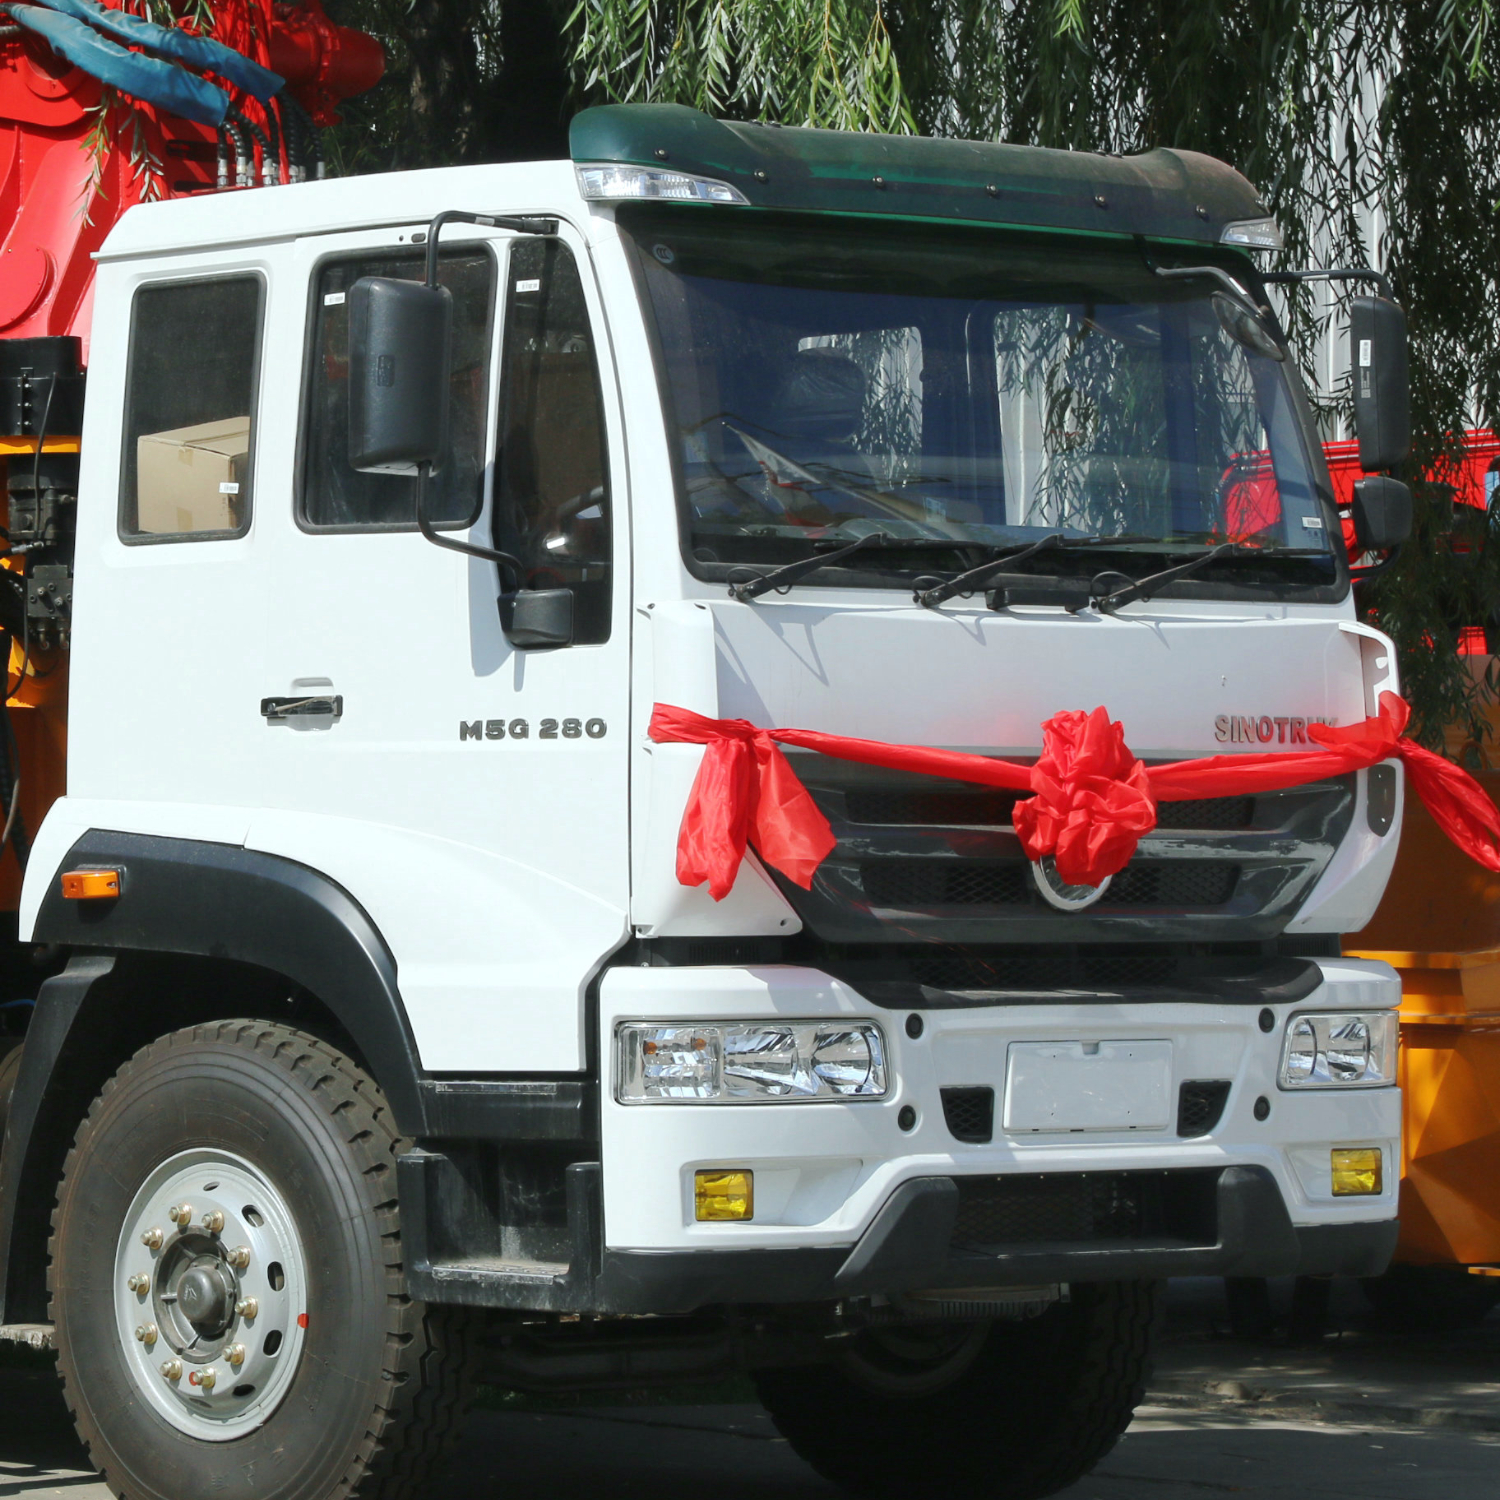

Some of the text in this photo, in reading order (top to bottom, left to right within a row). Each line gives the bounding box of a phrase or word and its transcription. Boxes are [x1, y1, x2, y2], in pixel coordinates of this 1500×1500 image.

[459, 718, 608, 741] M5G 280
[1214, 714, 1339, 744] SINOTR
